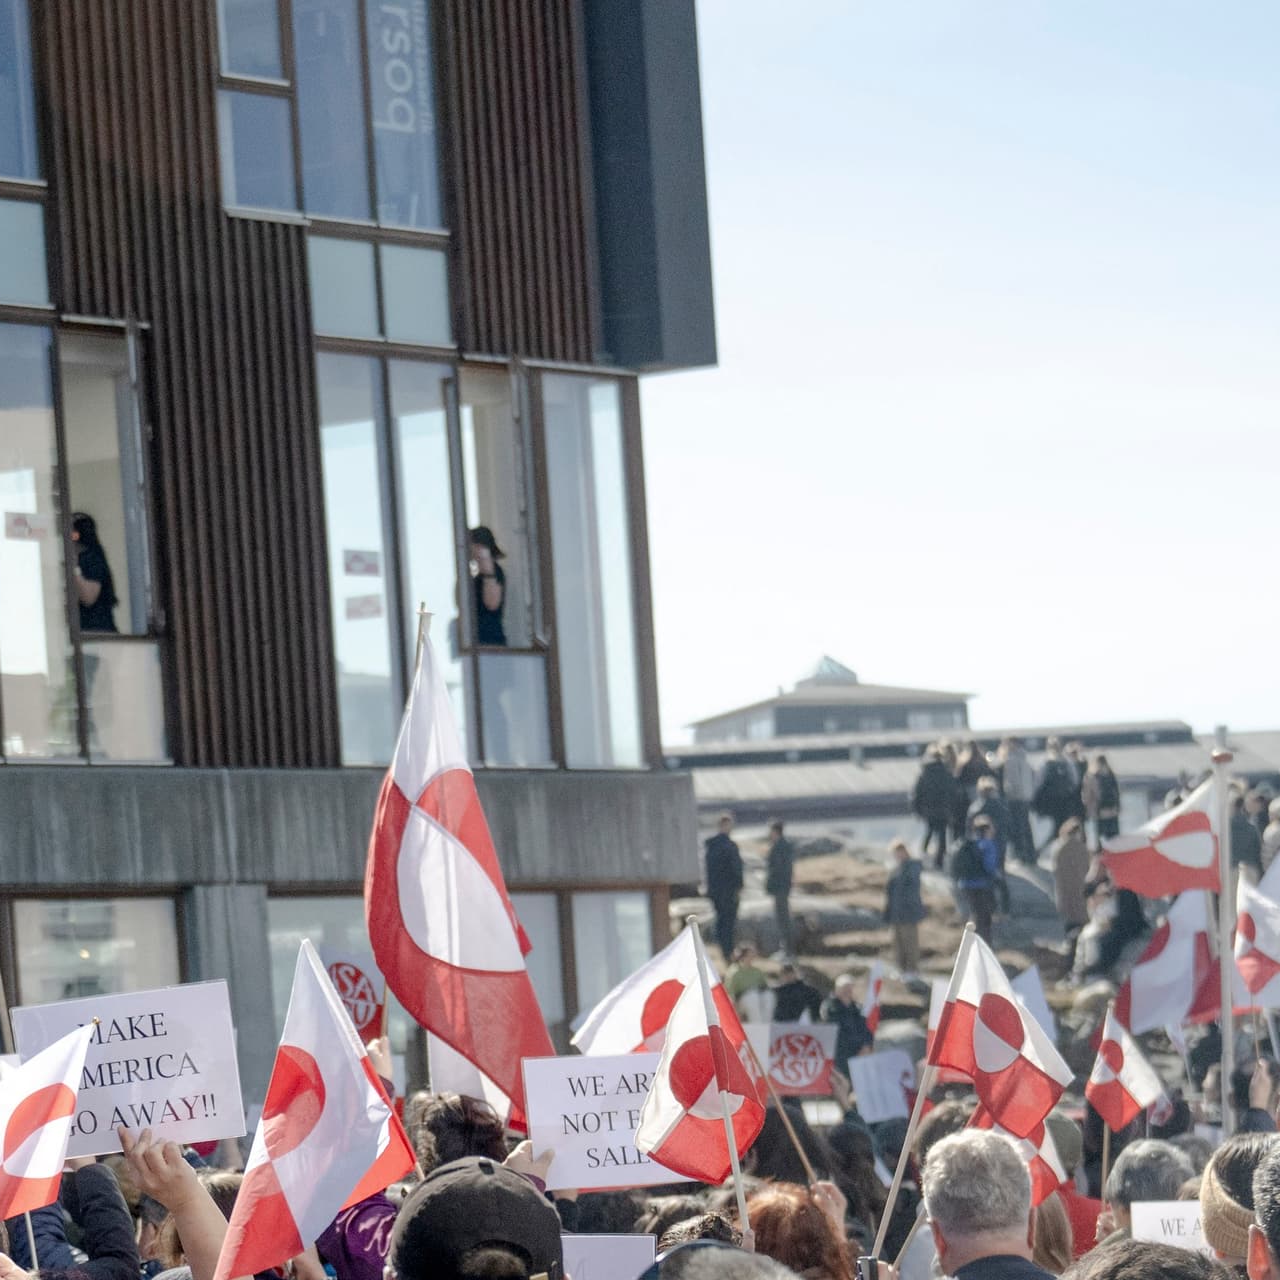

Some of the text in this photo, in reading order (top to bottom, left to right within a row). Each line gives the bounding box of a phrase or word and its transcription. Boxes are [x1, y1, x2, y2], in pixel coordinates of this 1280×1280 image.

[331, 964, 375, 1001] SA
[78, 1052, 201, 1091] MERICA
[567, 1071, 657, 1097] WE AR
[70, 1093, 218, 1137] O AWAY!!
[561, 1110, 618, 1135] NOT
[1160, 1217, 1186, 1237] WE
